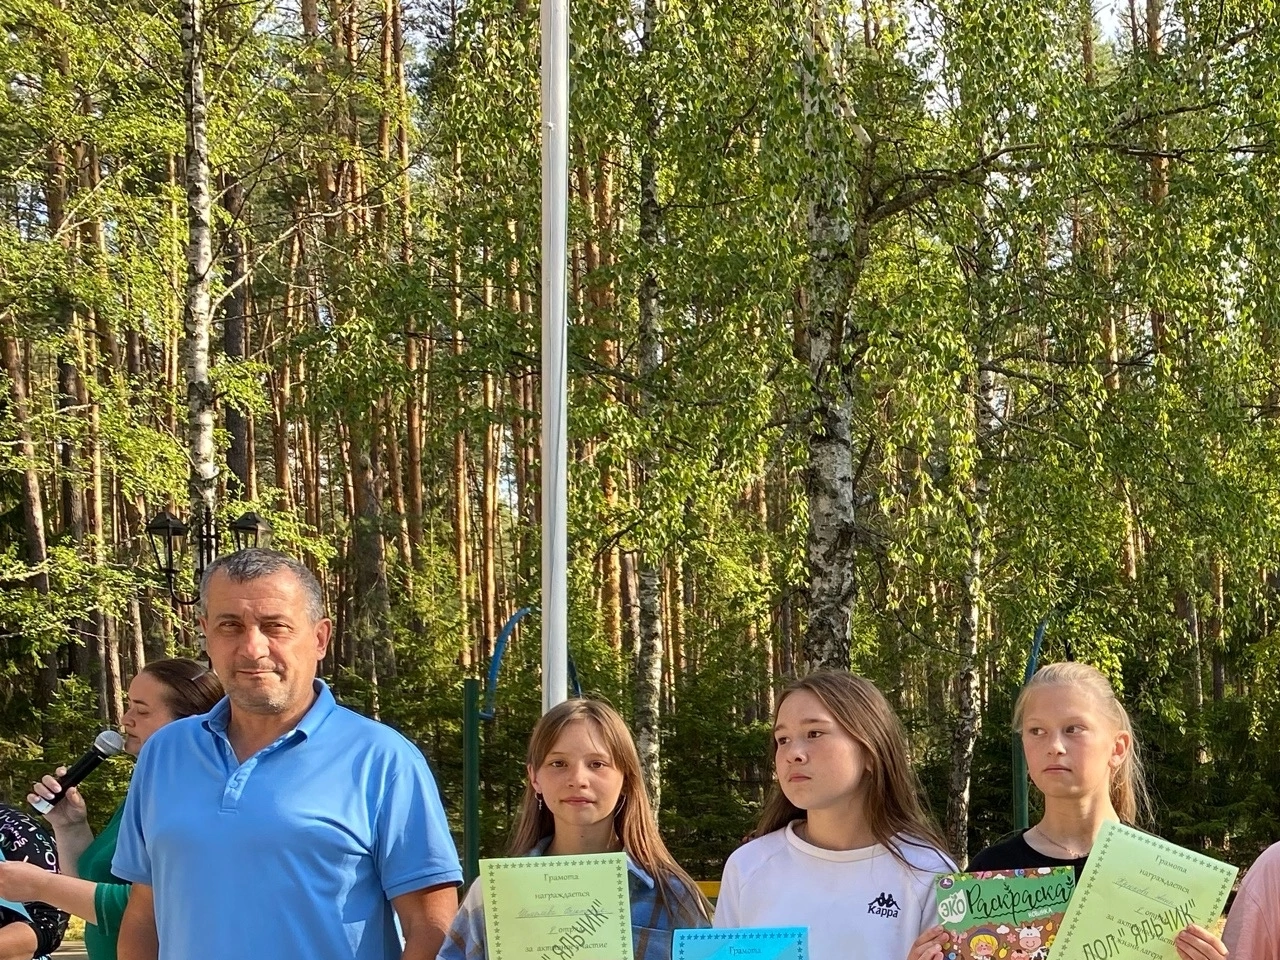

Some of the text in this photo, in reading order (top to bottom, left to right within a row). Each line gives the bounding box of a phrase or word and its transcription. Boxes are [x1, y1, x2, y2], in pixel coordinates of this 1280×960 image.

[1155, 854, 1188, 874] Грамота
[544, 873, 579, 883] Грамота
[1139, 868, 1190, 894] награждается
[535, 891, 590, 901] награждается
[940, 897, 966, 917] ЭКО
[966, 875, 1075, 925] Раскраска
[867, 905, 899, 918] Kappa
[729, 946, 761, 955] Грамота
[1141, 947, 1163, 960] лагеря
